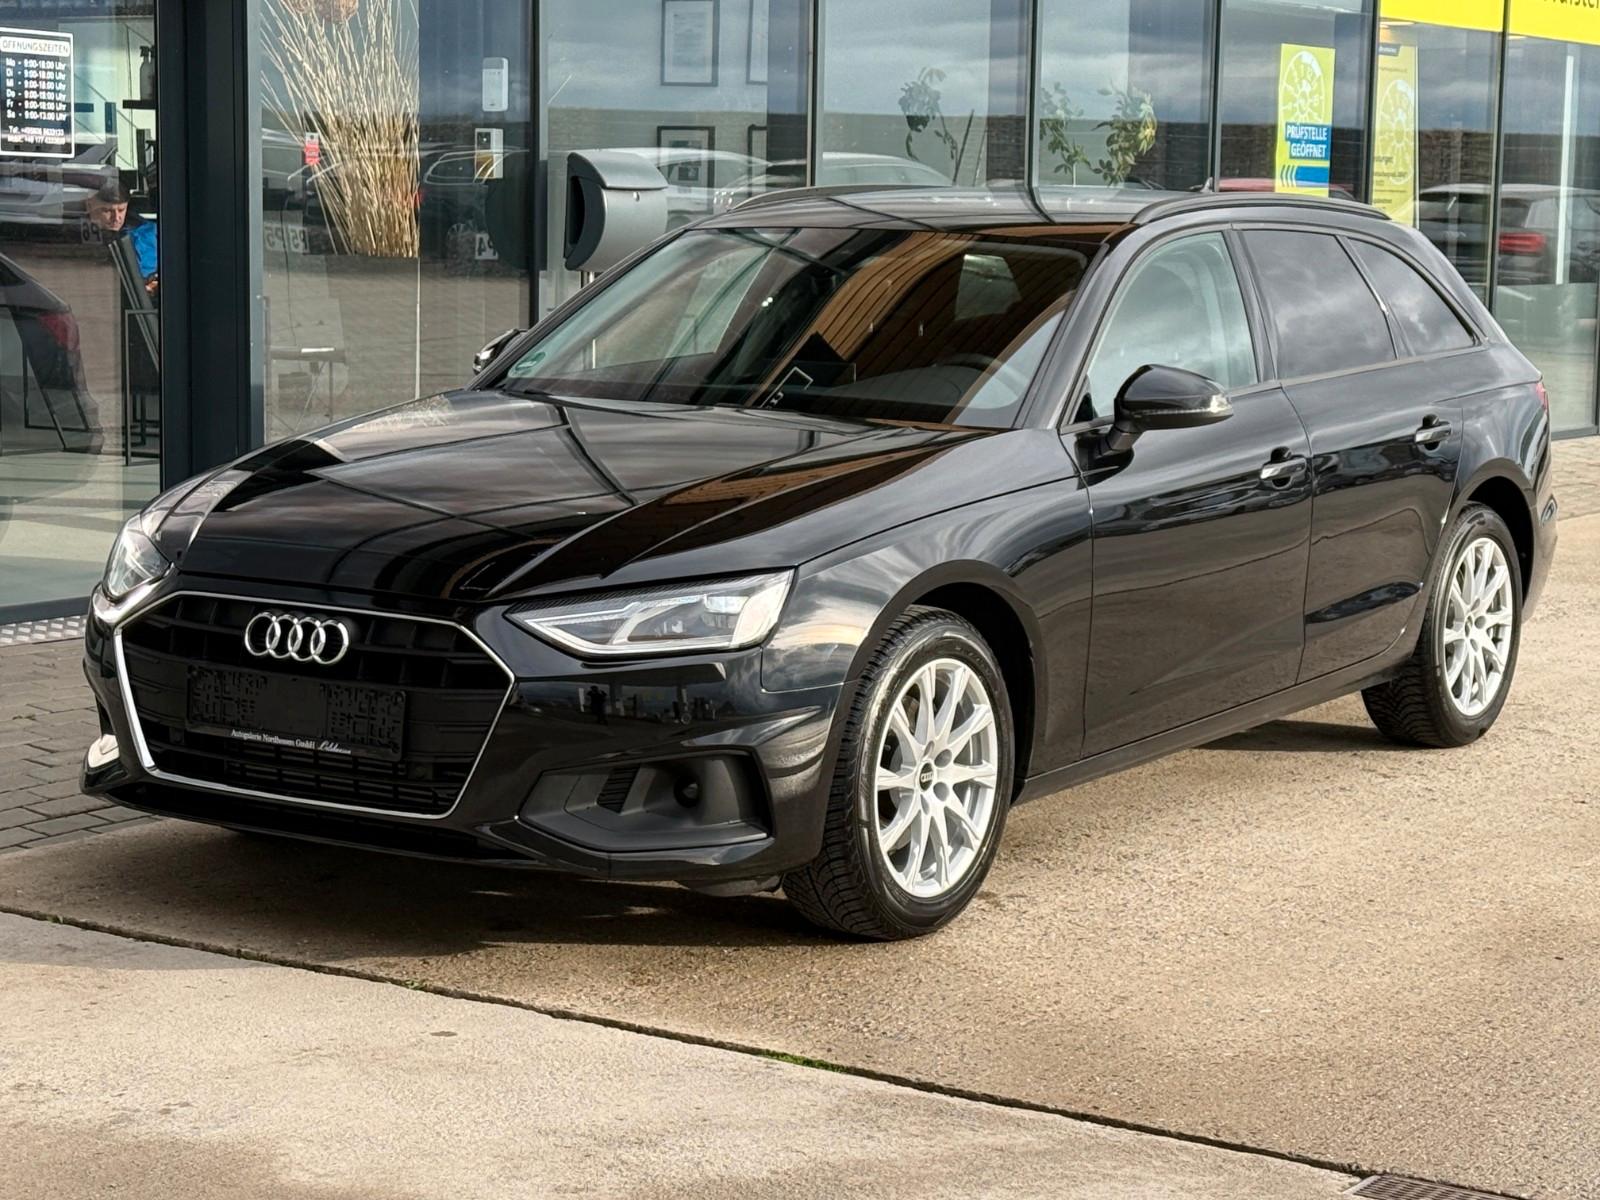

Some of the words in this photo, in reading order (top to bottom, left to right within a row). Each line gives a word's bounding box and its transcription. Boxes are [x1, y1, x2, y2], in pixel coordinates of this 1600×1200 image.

[7, 98, 14, 108] Fr
[1290, 140, 1327, 158] GEÖFFNET
[295, 739, 315, 750] GmbH
